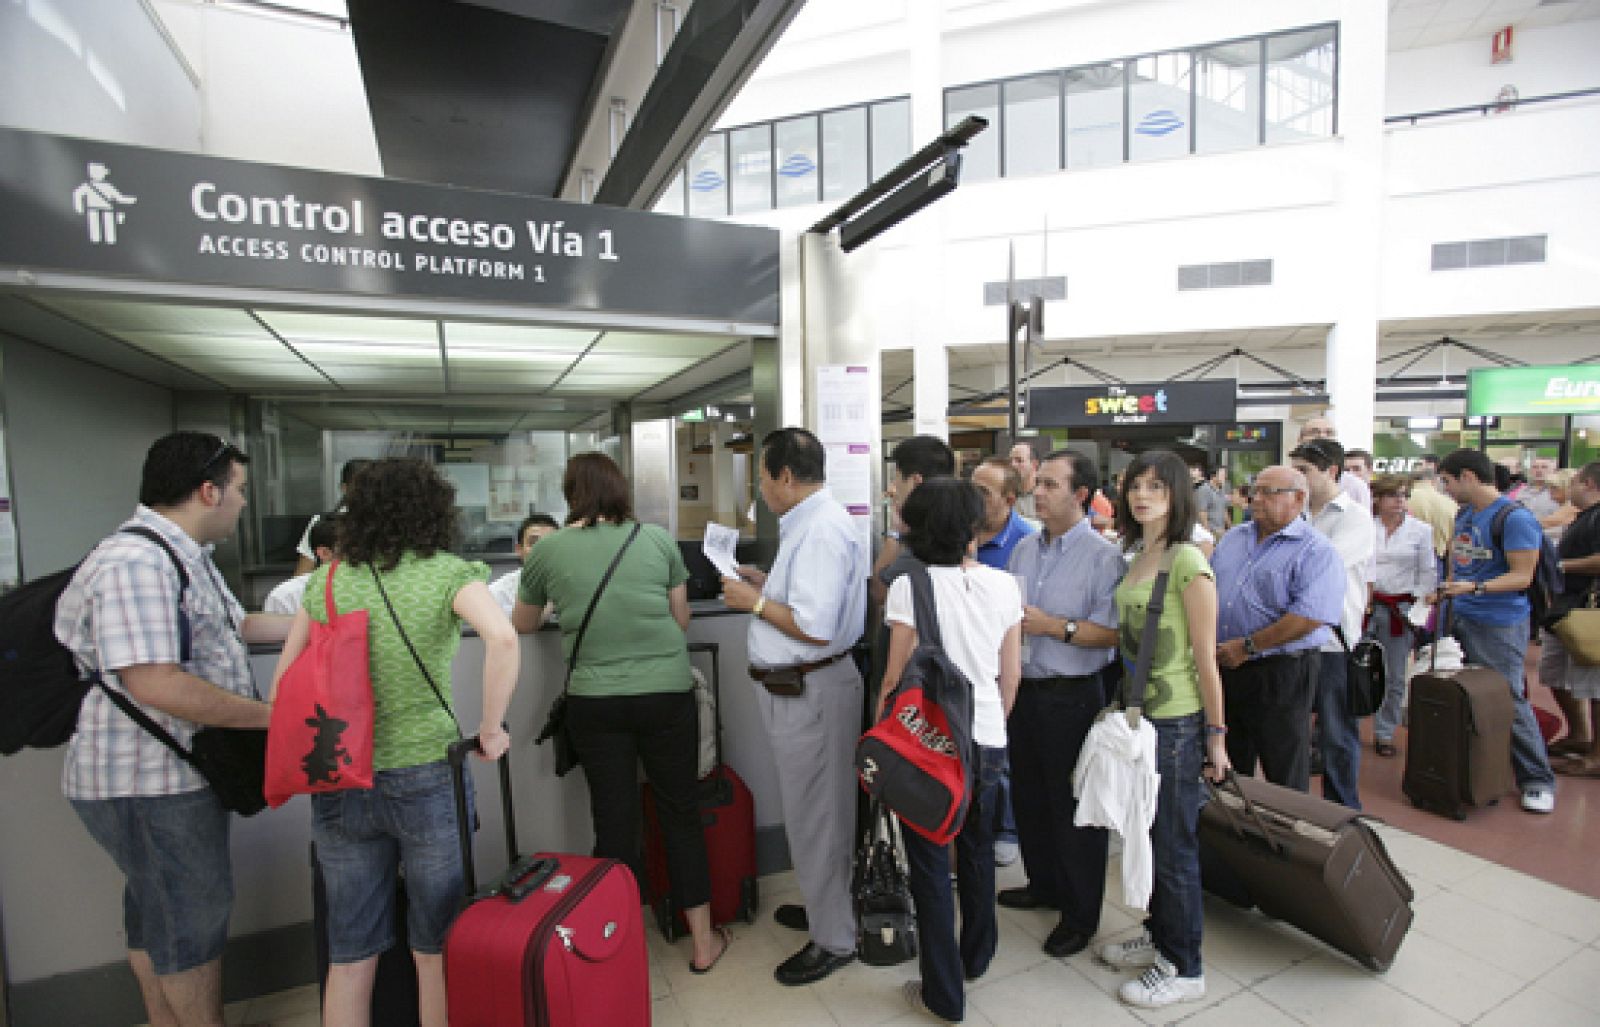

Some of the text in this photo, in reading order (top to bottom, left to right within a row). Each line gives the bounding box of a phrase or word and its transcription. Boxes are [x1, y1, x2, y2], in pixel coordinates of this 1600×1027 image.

[191, 181, 620, 262] Control acceso Vía 1
[199, 233, 546, 283] ACCESS CONTROL PLATFORM 1
